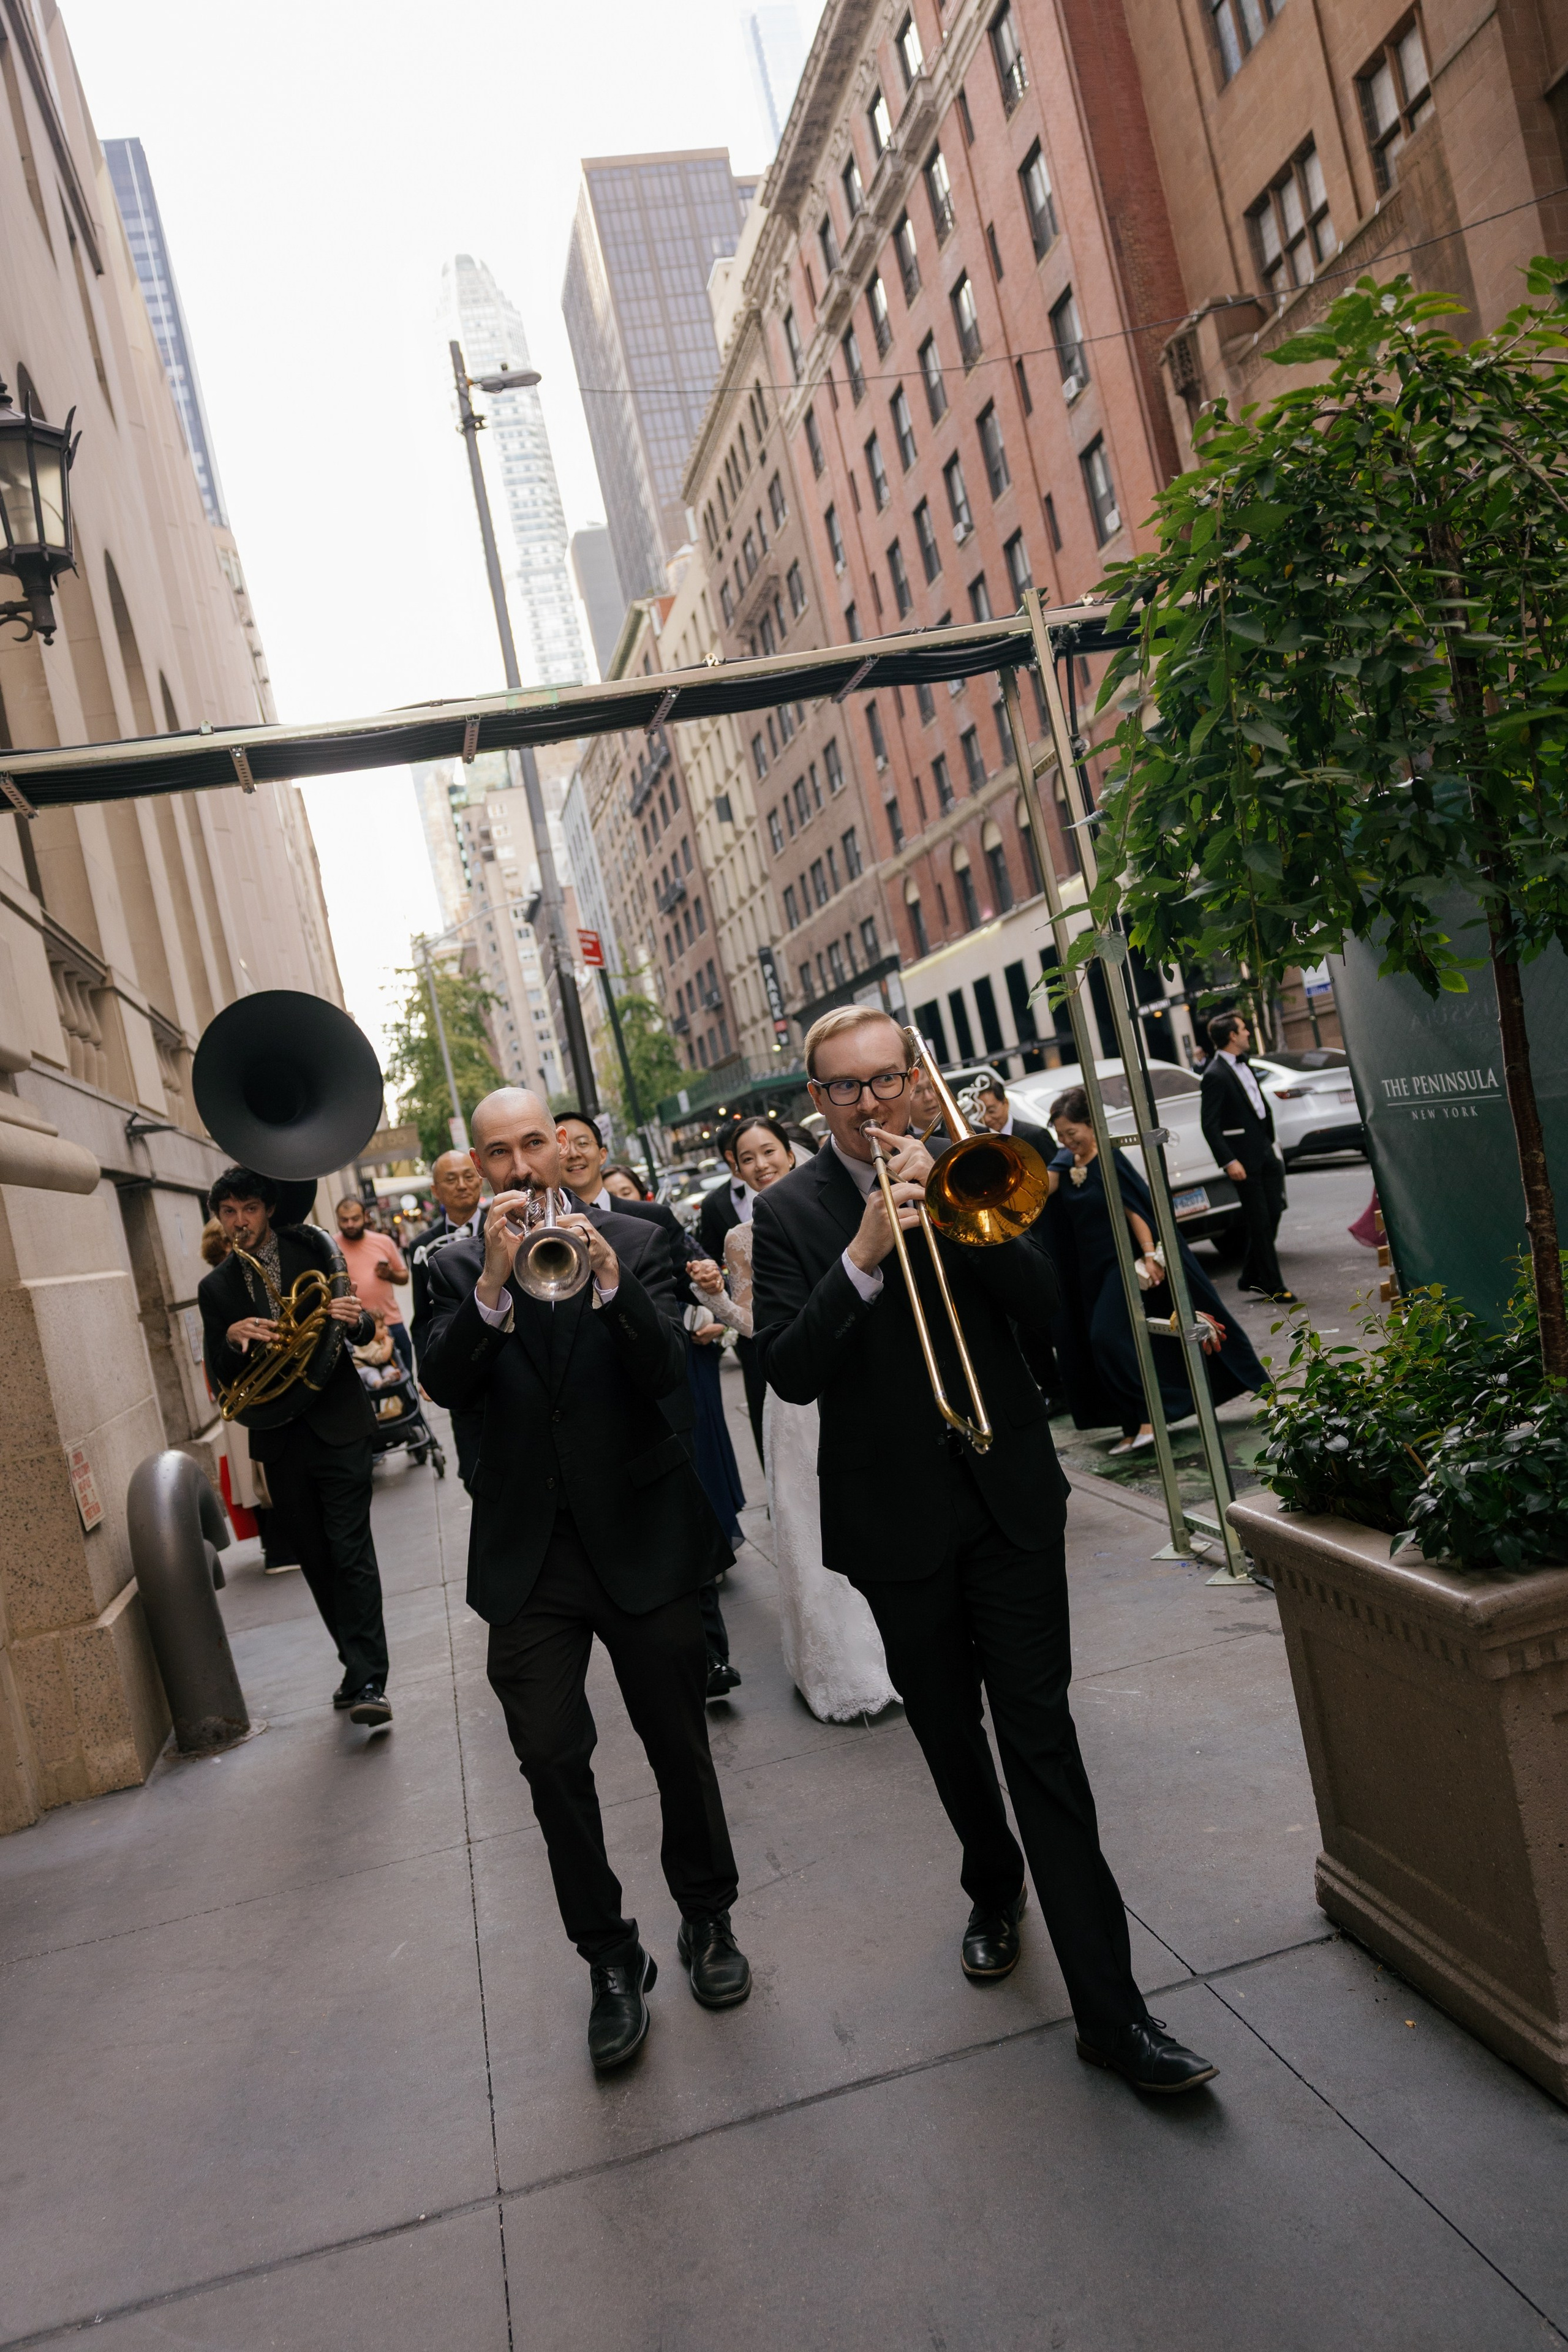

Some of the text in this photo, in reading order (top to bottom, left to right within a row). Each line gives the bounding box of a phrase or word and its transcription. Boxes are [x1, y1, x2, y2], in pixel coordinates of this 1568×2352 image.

[1382, 1078, 1410, 1098] THE
[1412, 1068, 1500, 1095] PENINSULA
[1411, 1106, 1478, 1120] NEW YORK
